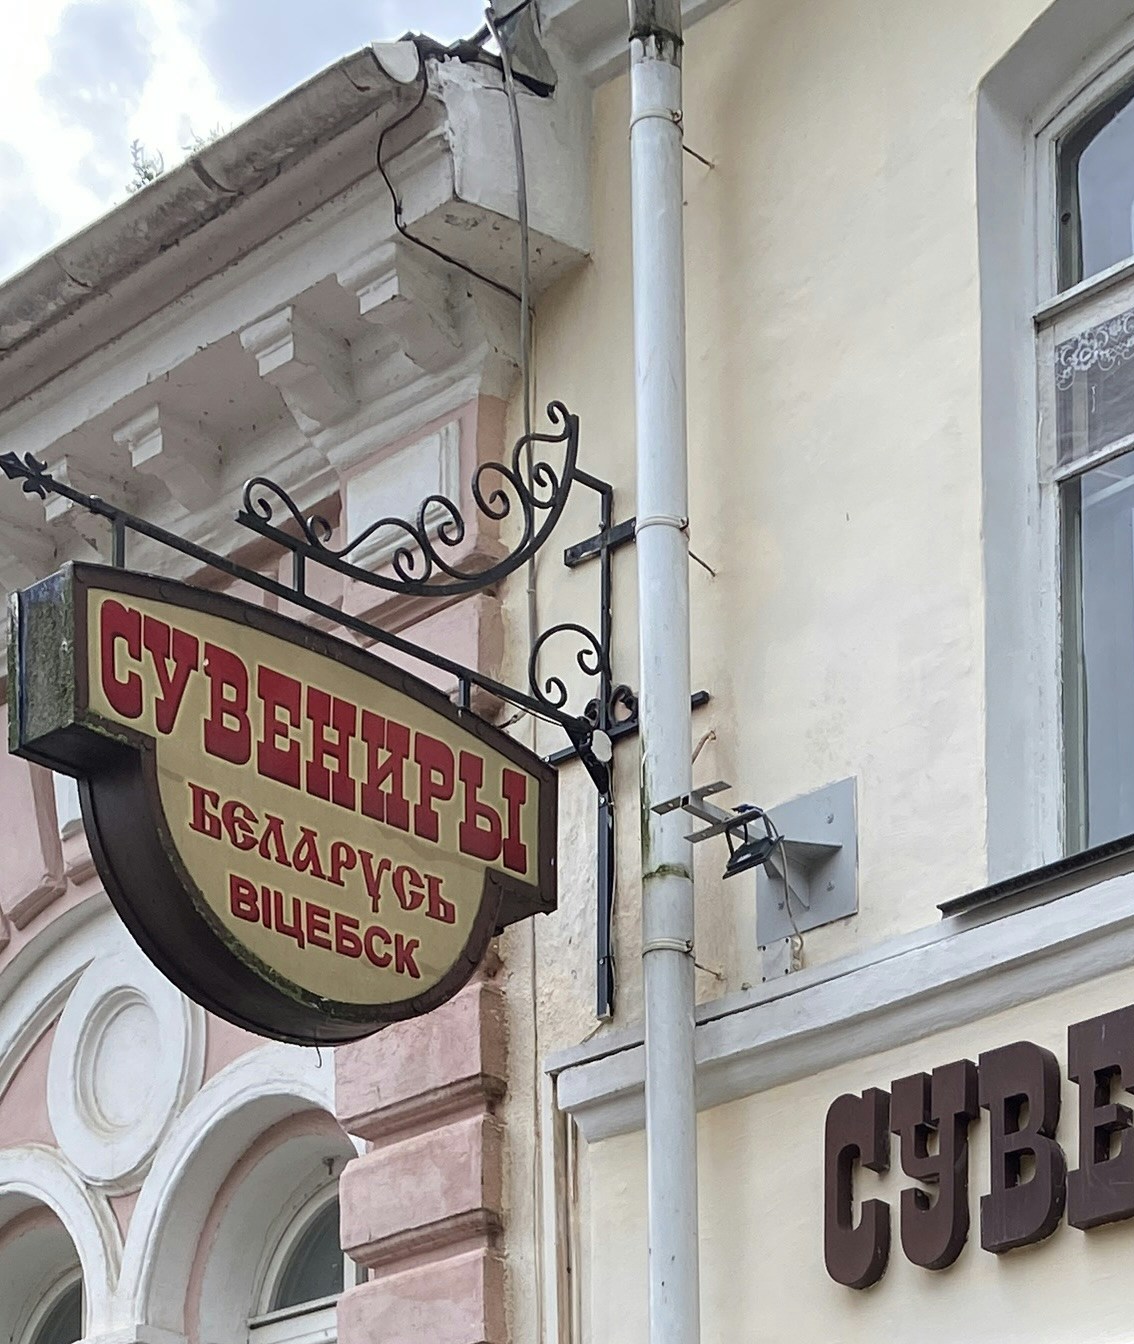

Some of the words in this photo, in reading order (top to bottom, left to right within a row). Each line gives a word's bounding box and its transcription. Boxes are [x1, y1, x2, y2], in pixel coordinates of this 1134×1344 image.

[100, 598, 529, 875] СУВЕНИРЫ
[188, 782, 457, 925] БЕЛАРУСЬ
[230, 873, 421, 980] ВІЦЕБСК
